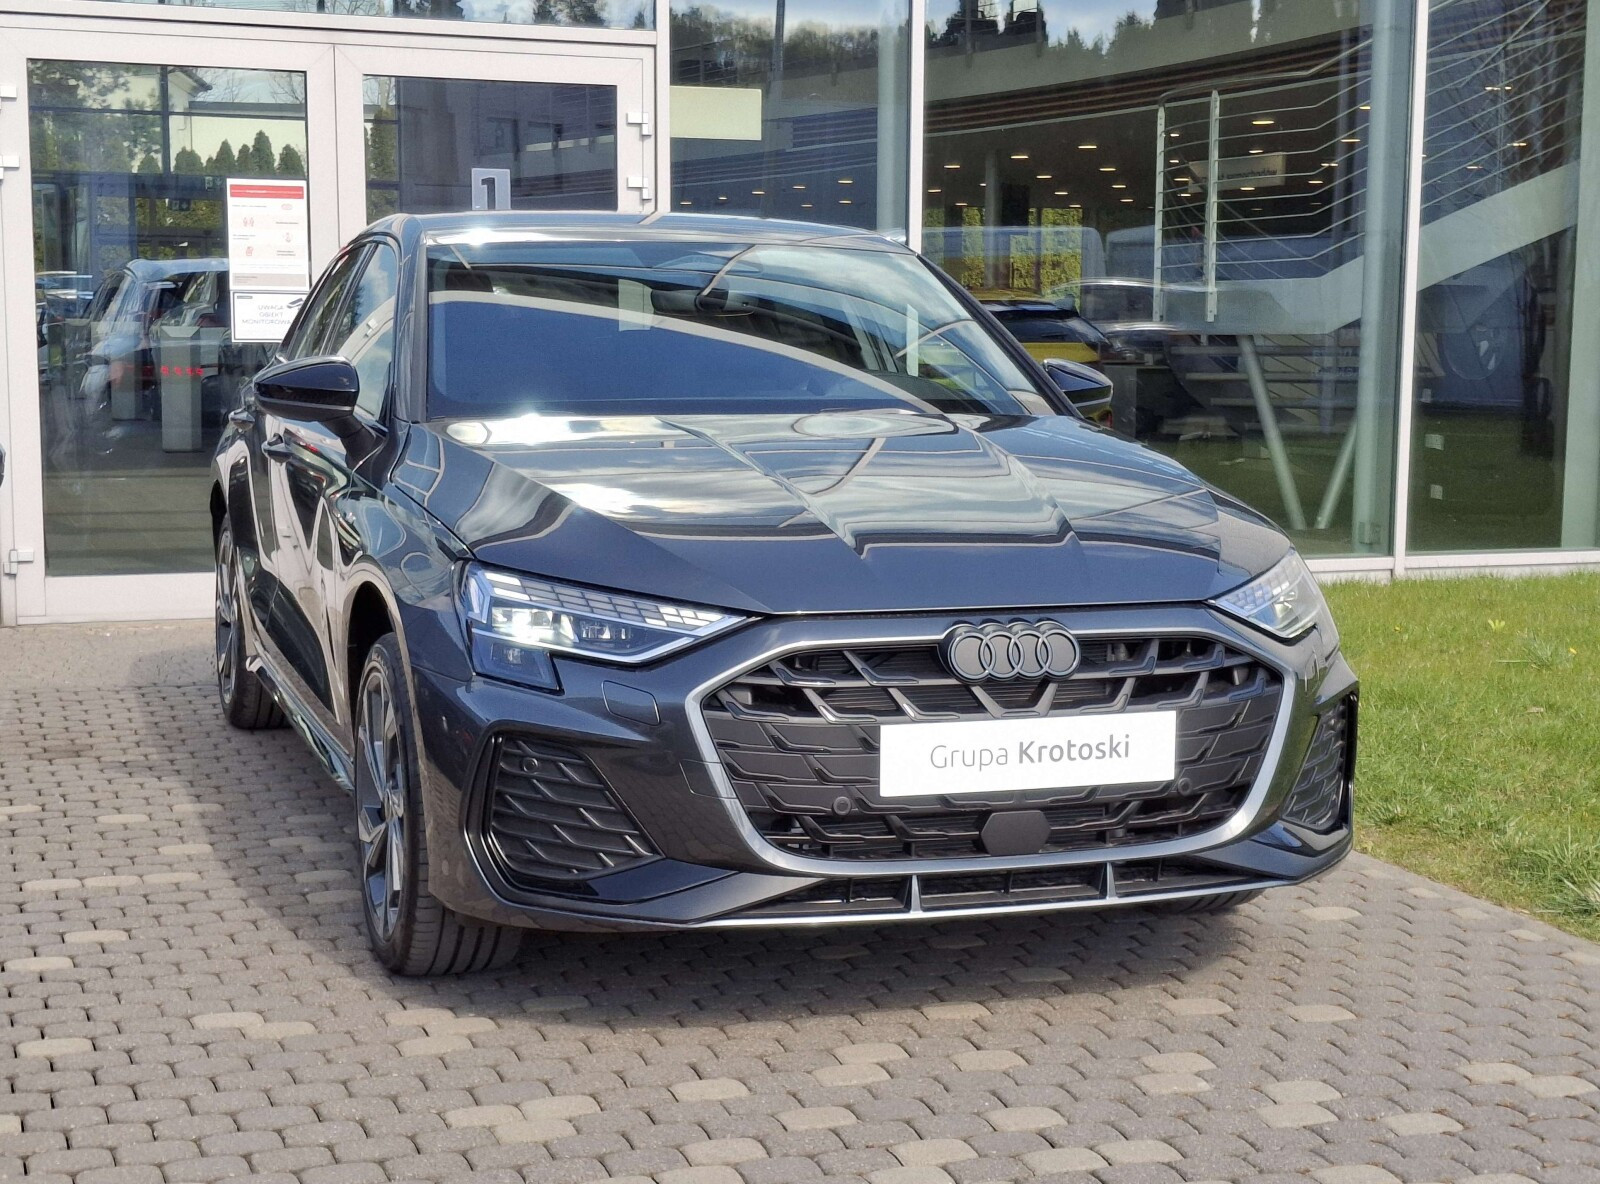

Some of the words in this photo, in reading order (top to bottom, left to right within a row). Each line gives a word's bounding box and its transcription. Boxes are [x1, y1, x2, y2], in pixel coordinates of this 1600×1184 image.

[481, 176, 496, 210] 1
[930, 745, 1009, 772] Grupa
[1018, 734, 1130, 764] Krotoski
